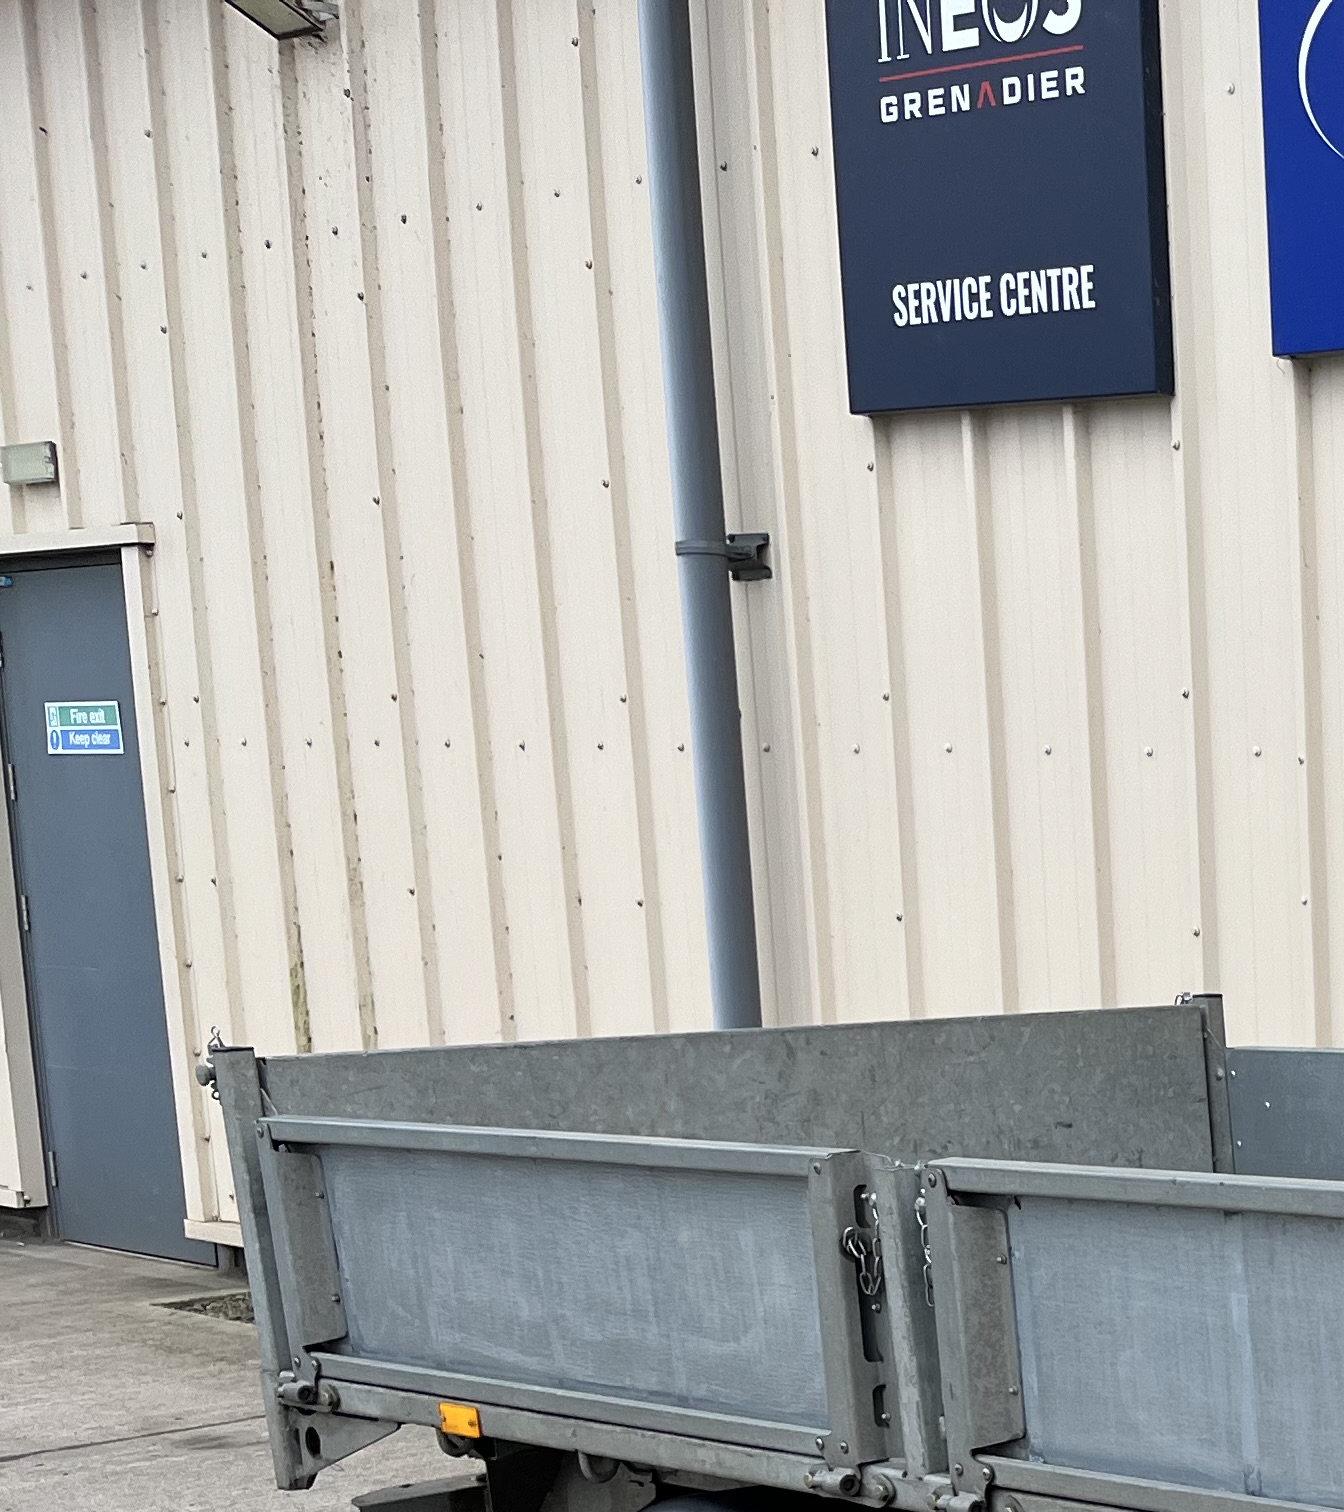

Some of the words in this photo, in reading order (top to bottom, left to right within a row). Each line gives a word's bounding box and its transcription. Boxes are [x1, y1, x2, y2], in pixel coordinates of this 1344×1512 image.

[880, 66, 1086, 123] GRENADIER
[892, 275, 994, 327] SERVICE
[1000, 264, 1096, 317] CENTRE
[70, 708, 88, 724] Fire
[90, 708, 106, 723] exit
[69, 731, 90, 748] Keep
[91, 731, 111, 745] clear
